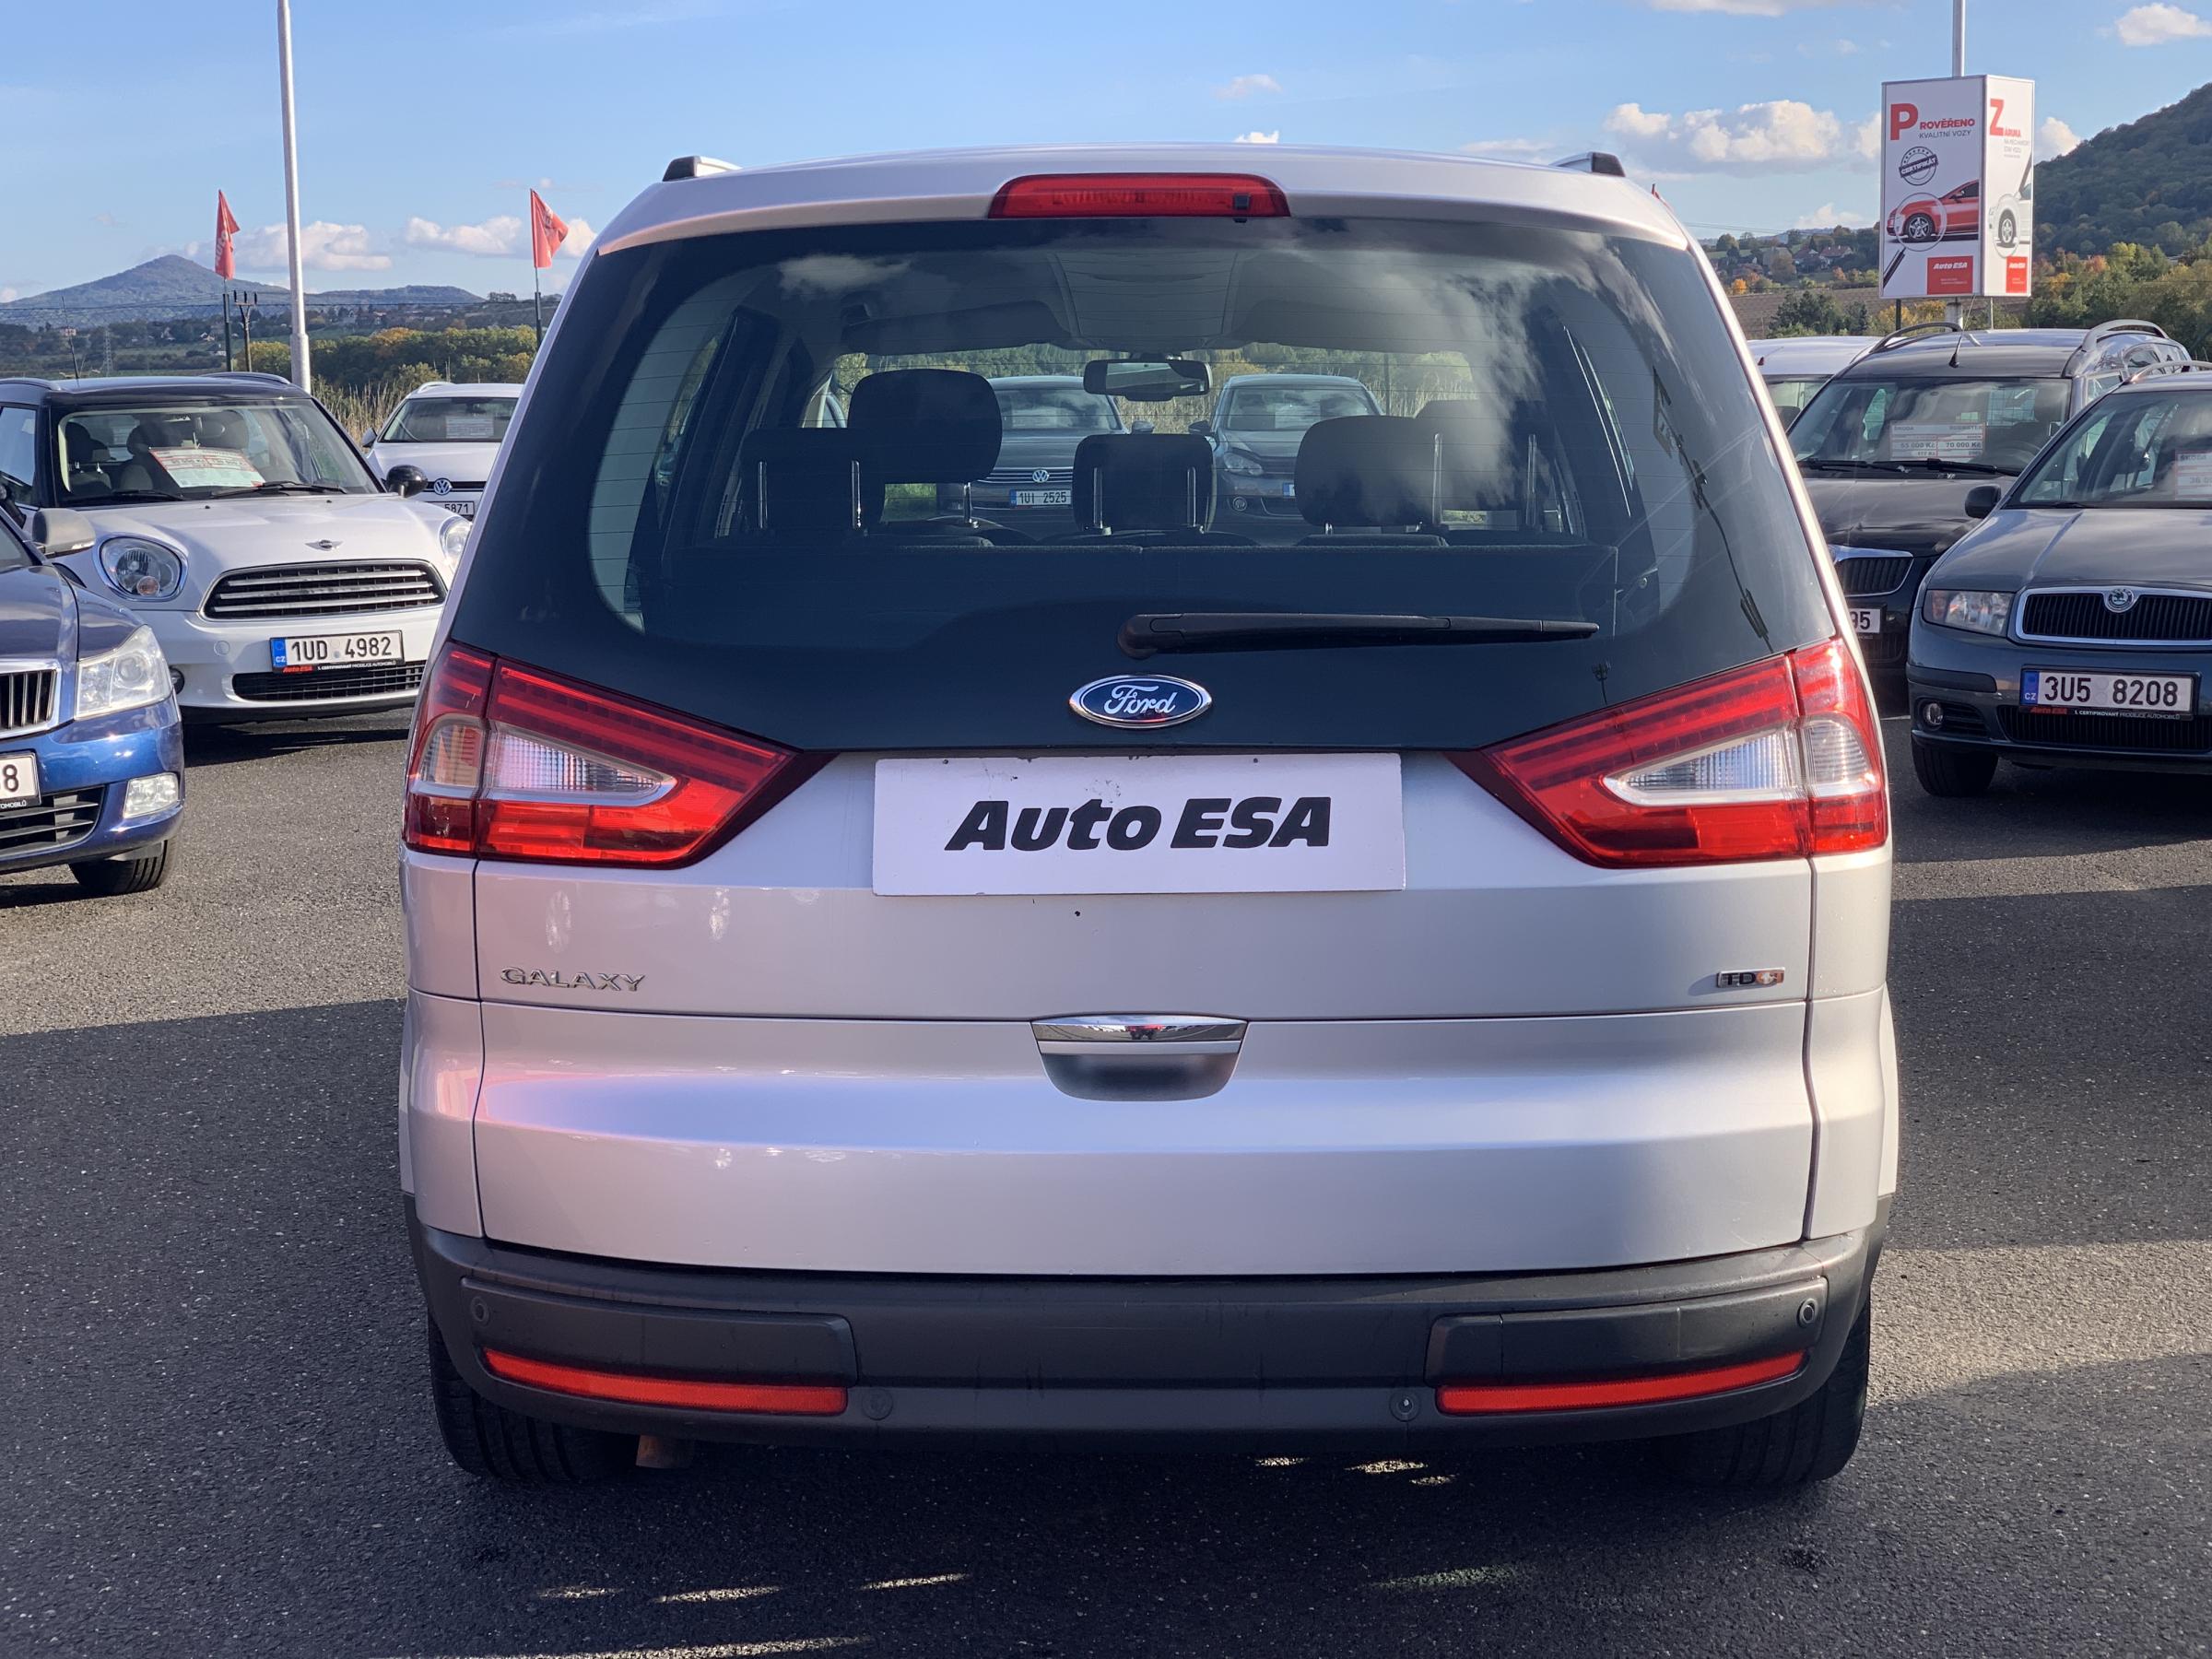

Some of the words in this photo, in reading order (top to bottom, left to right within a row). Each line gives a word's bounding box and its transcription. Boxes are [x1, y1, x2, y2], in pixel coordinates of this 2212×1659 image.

[1918, 131, 1950, 139] KVALITNÍ
[1043, 491, 1067, 503] 2525
[291, 640, 328, 662] 1UD
[345, 636, 392, 658] 4982
[1103, 684, 1178, 714] Ford
[2024, 692, 2037, 700] CZ
[2044, 676, 2091, 703] 3U5
[2112, 678, 2179, 707] 8208
[944, 798, 1162, 852] Auto
[1170, 796, 1332, 849] ESA
[500, 967, 645, 992] GALAXY
